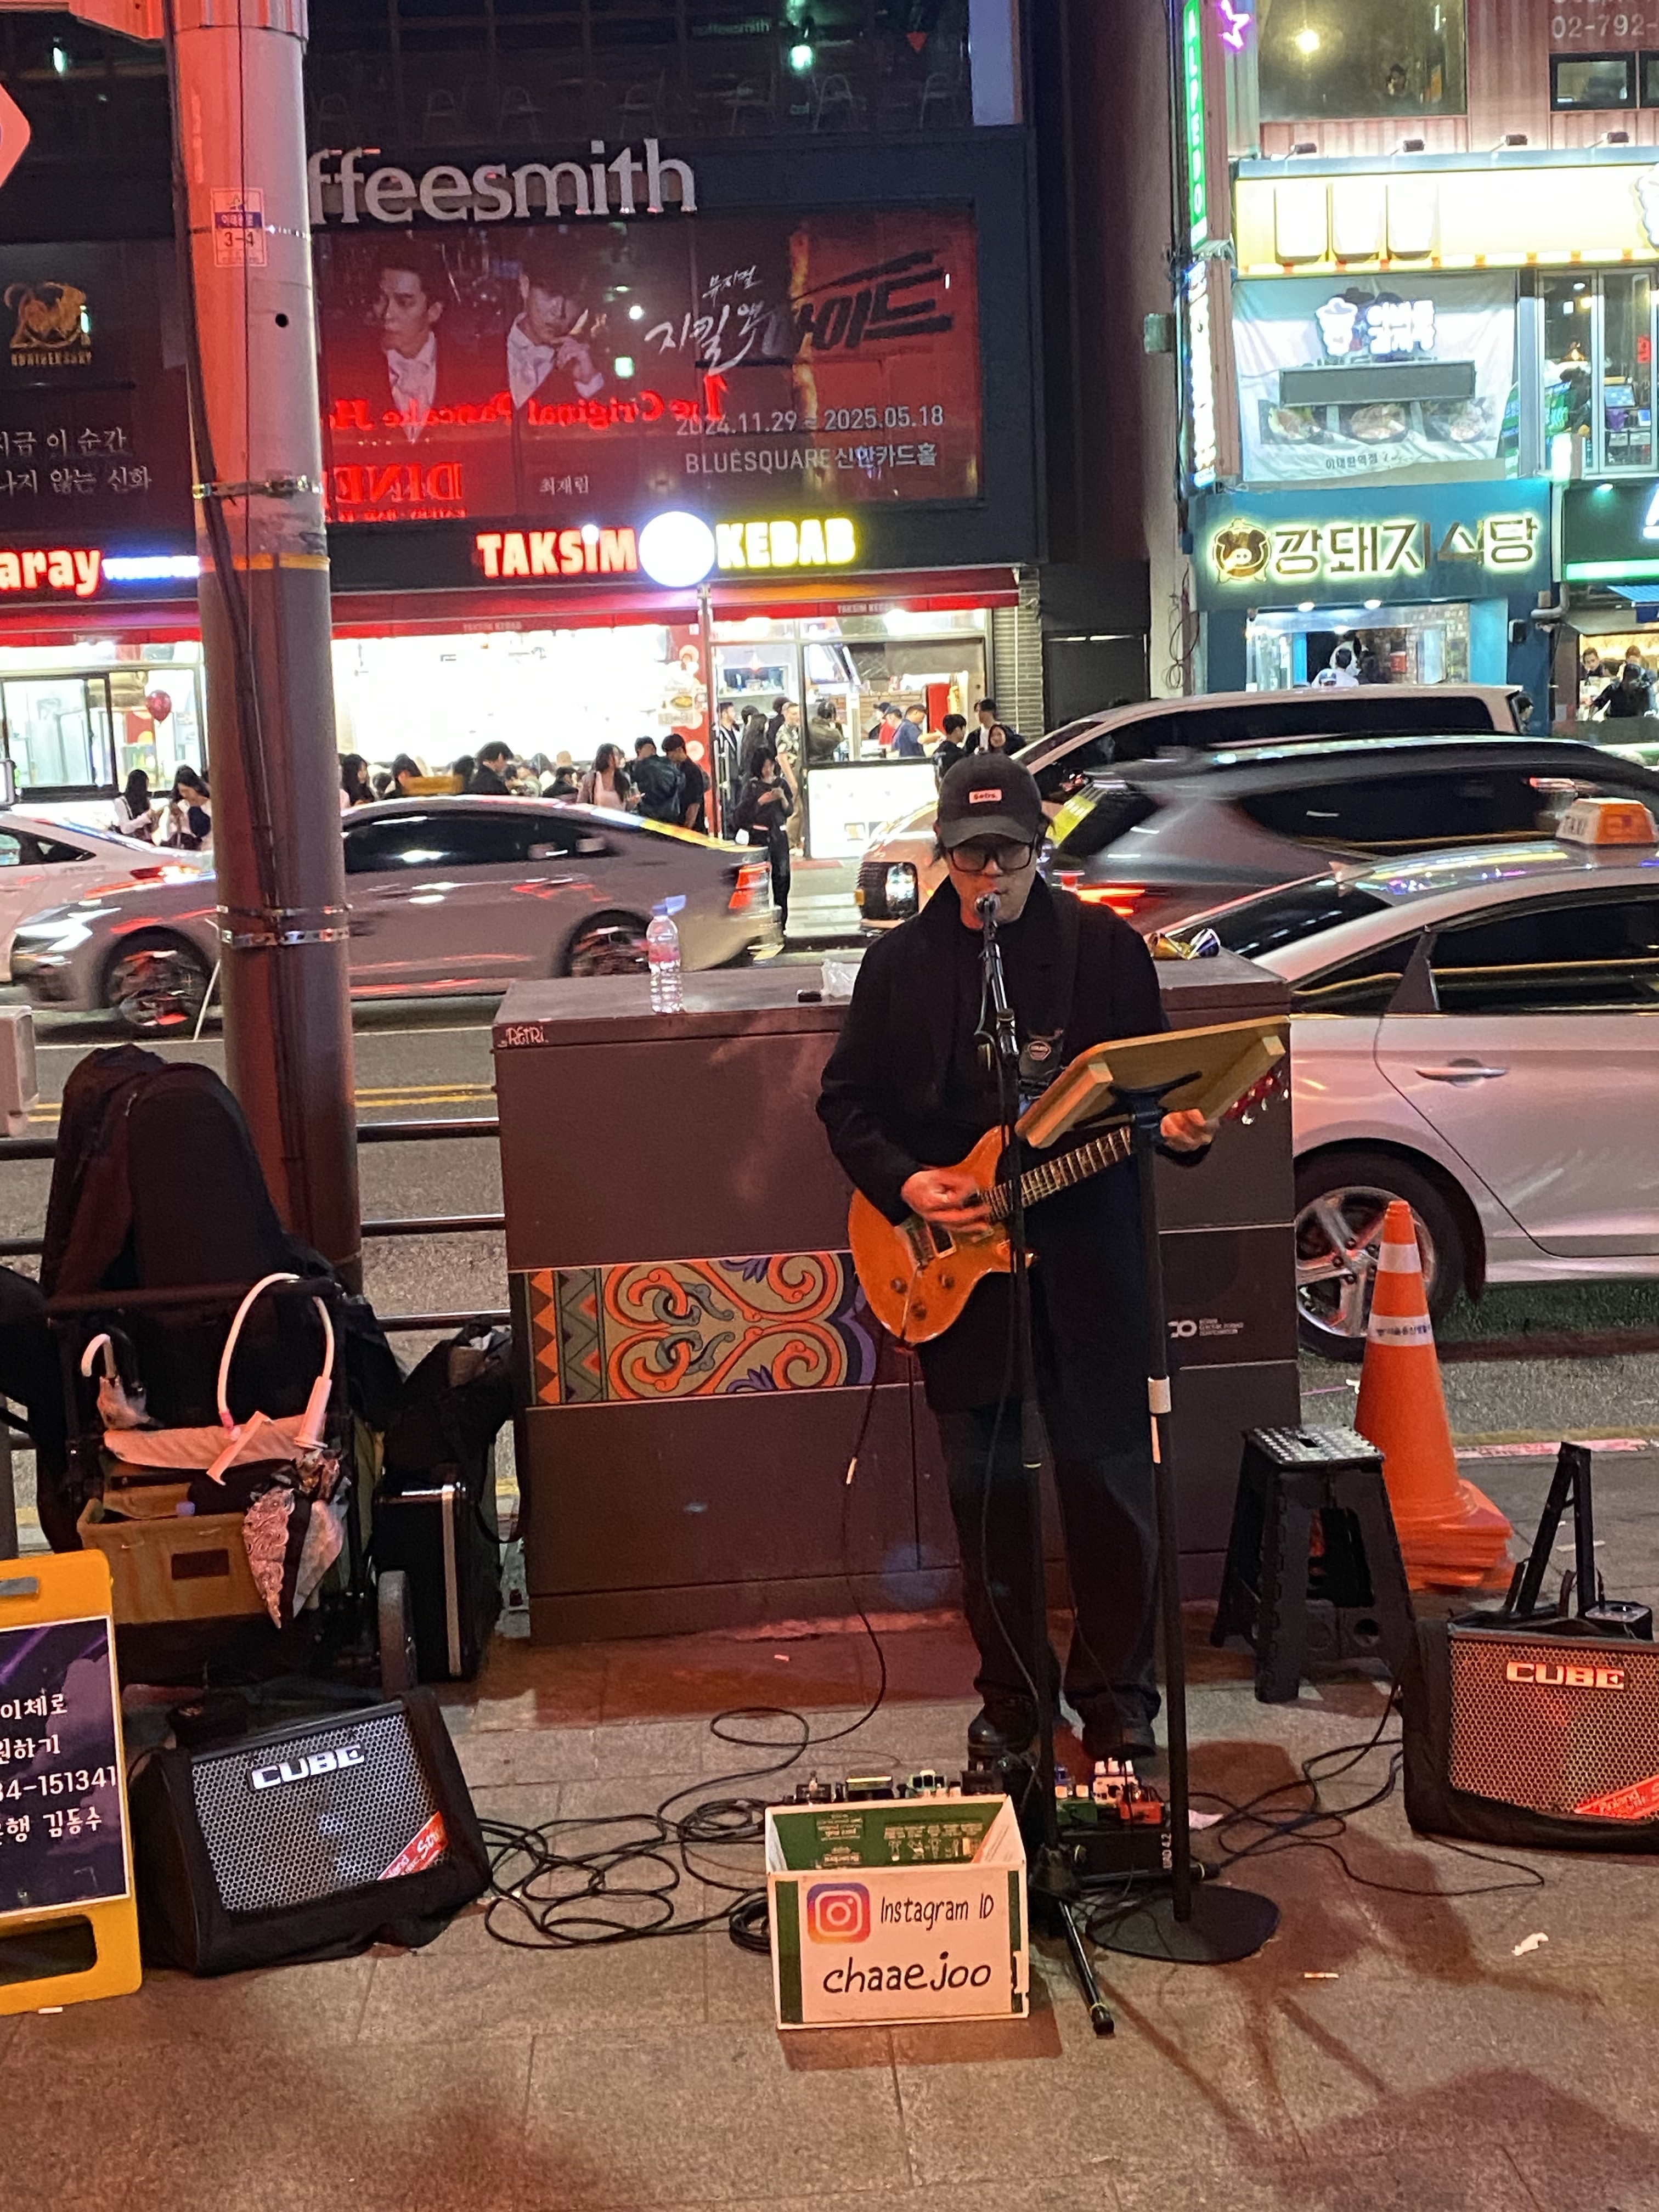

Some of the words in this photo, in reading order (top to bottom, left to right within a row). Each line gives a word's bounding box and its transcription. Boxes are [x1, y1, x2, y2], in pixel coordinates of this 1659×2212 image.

[825, 404, 943, 431] 2025.05.18
[47, 428, 67, 456] 이
[78, 427, 127, 456] 순간
[686, 447, 832, 475] BLUESQUARE
[834, 442, 936, 469] 신한카드홀
[50, 468, 97, 494] 않는
[108, 466, 153, 492] 신화
[715, 518, 856, 568] KEBAB
[1437, 518, 1538, 565] 식당
[1507, 1662, 1624, 1690] CUBE
[252, 1744, 365, 1790] CUBE
[0, 1815, 30, 1846] 행
[43, 1806, 102, 1837] 김동수
[881, 1897, 968, 1931] Instagram
[980, 1893, 994, 1918] ID
[823, 1951, 991, 1993] chaaejoo
